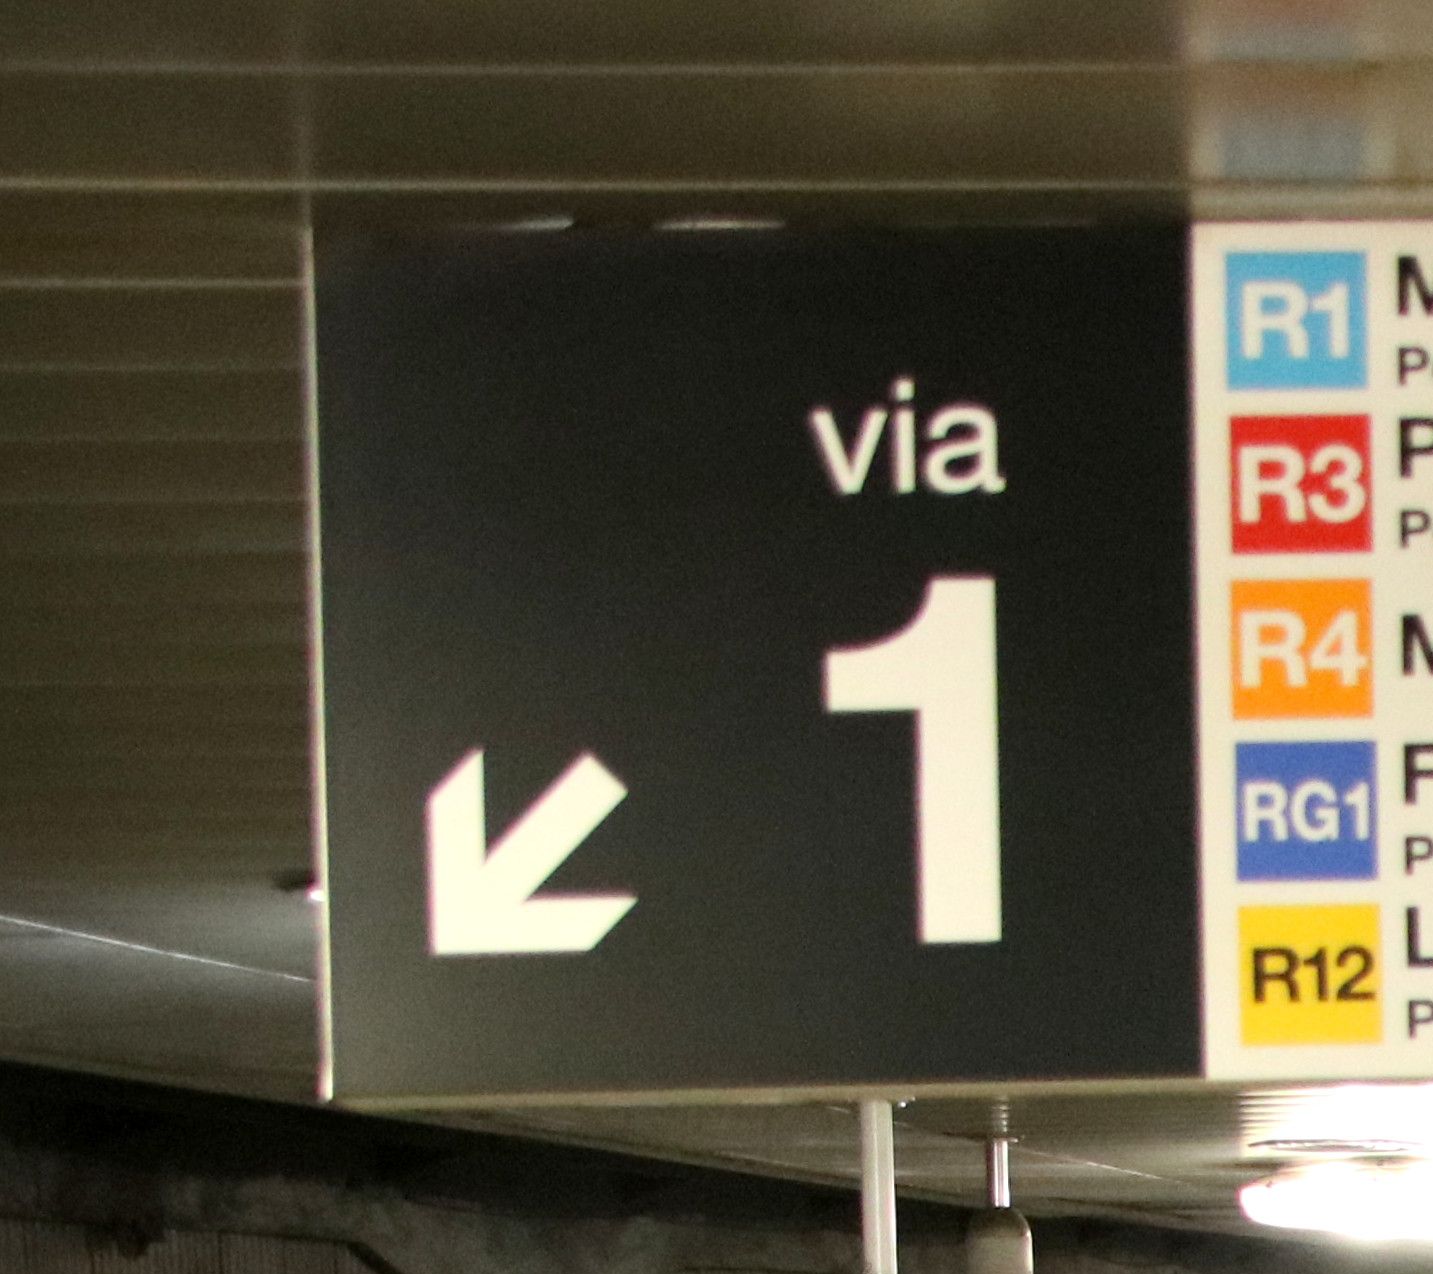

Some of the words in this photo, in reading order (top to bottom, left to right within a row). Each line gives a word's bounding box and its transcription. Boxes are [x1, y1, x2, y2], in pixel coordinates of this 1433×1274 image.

[1240, 281, 1350, 360] R1
[812, 379, 1006, 494] via
[1238, 443, 1366, 524] R3
[1239, 609, 1366, 690] R4
[825, 576, 1002, 945] 1
[1243, 780, 1371, 842] RG1
[1252, 945, 1374, 1003] R12
